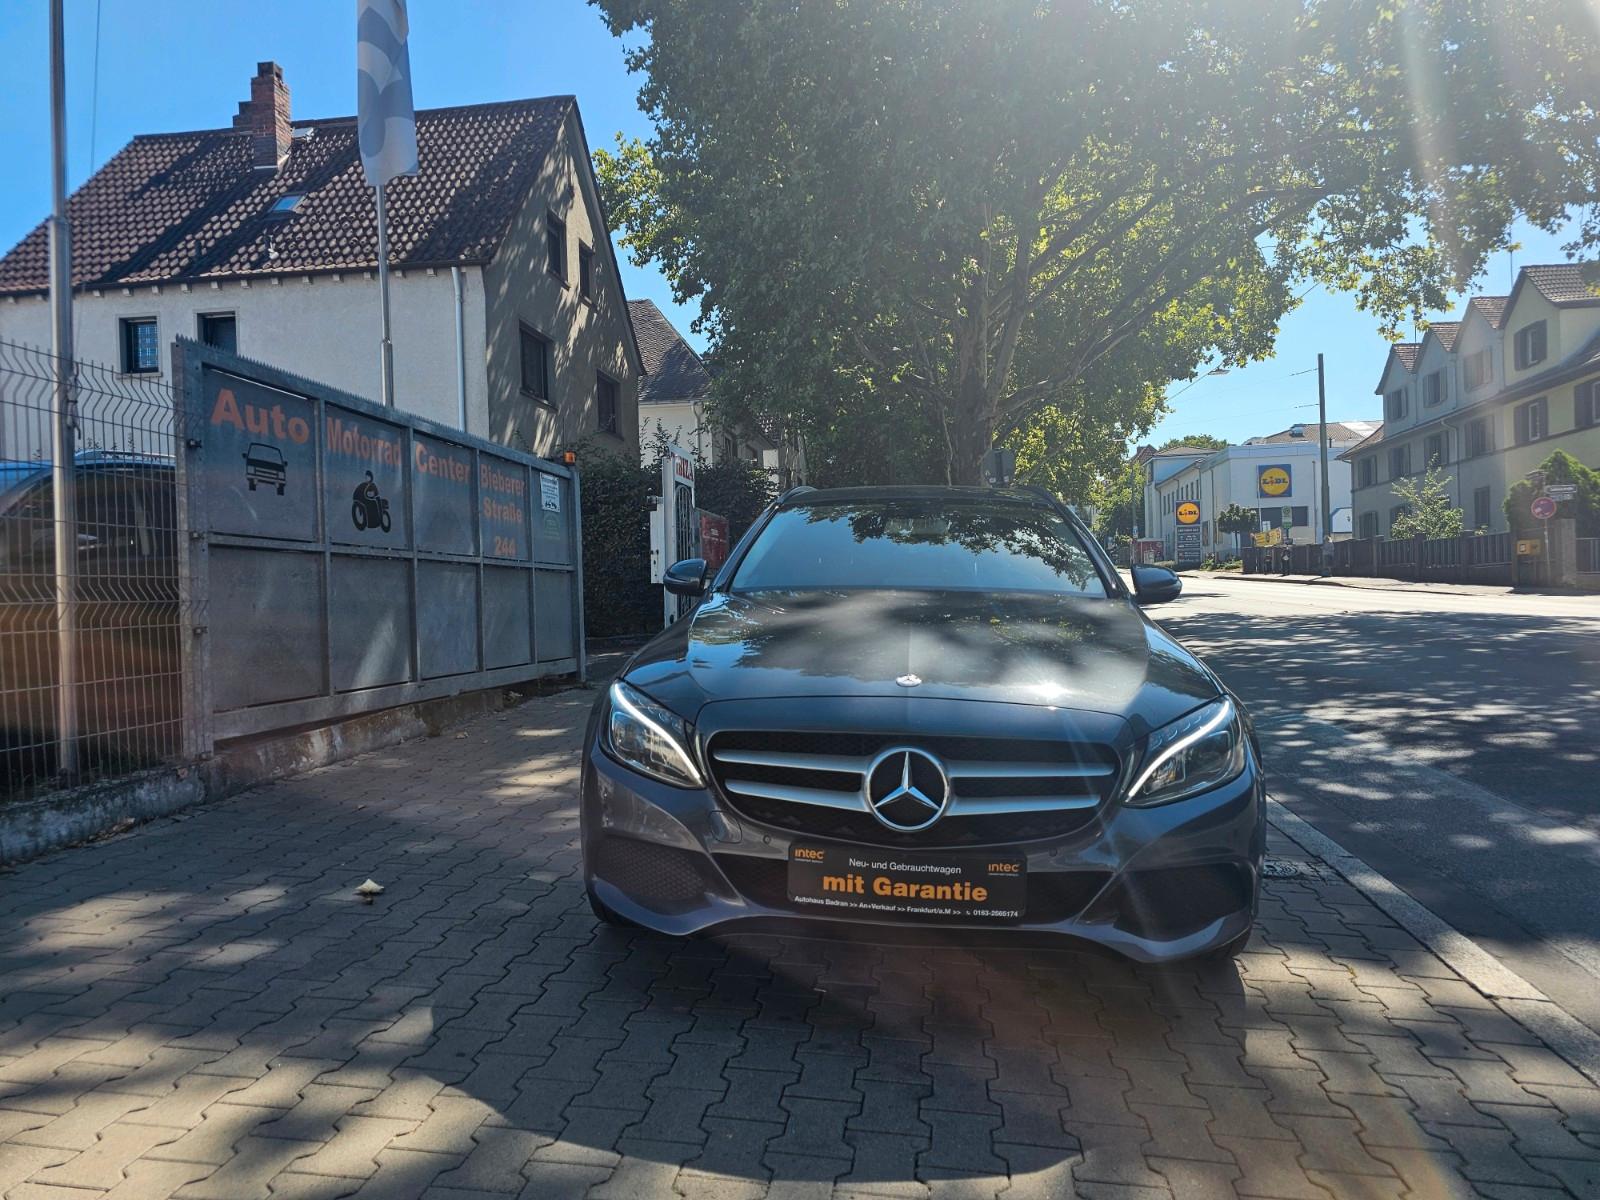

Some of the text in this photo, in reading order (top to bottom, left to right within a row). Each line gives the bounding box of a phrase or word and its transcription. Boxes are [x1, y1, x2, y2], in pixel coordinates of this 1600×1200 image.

[210, 387, 471, 484] Auto Motorrad Center
[480, 463, 525, 496] Bieberer
[794, 848, 824, 860] intec
[849, 857, 962, 875] Neu- und Gebrauchtwagen
[988, 862, 1020, 873] intec
[823, 873, 988, 902] mit Garantie
[794, 895, 825, 905] Autohaus
